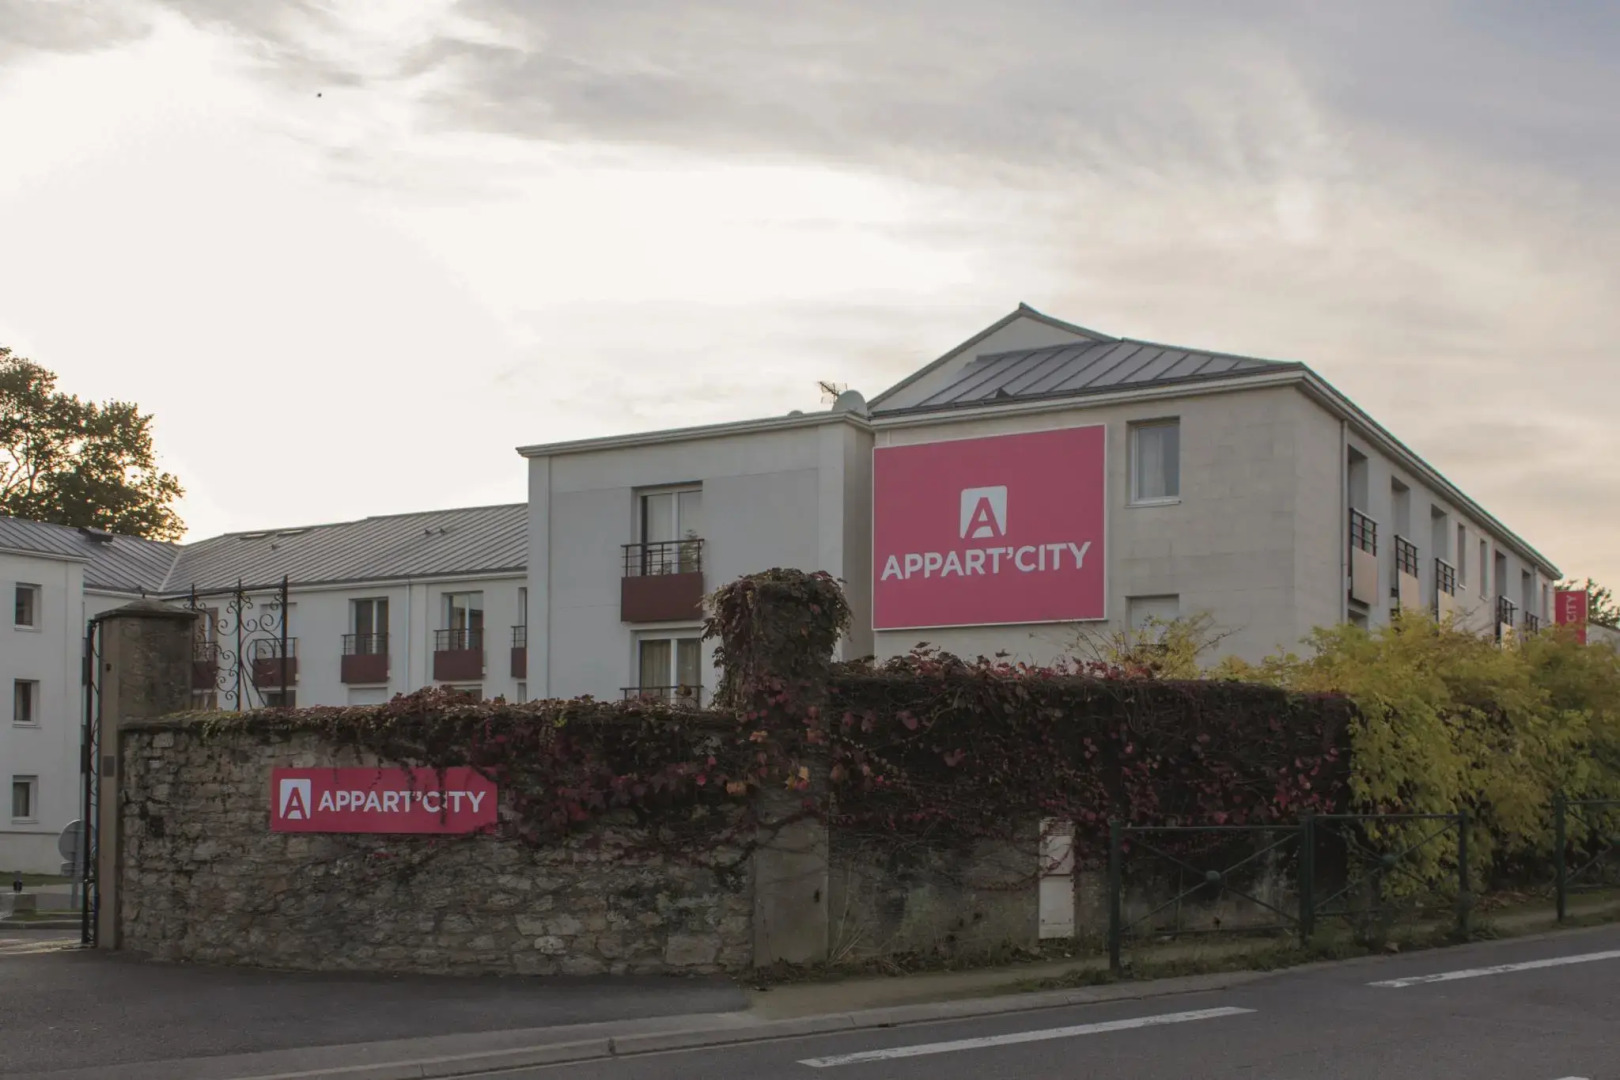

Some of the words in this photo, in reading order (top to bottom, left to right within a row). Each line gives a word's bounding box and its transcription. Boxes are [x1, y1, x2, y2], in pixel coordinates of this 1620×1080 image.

[964, 496, 1002, 538] A
[880, 541, 1092, 581] APPART'CITY
[282, 786, 309, 819] A
